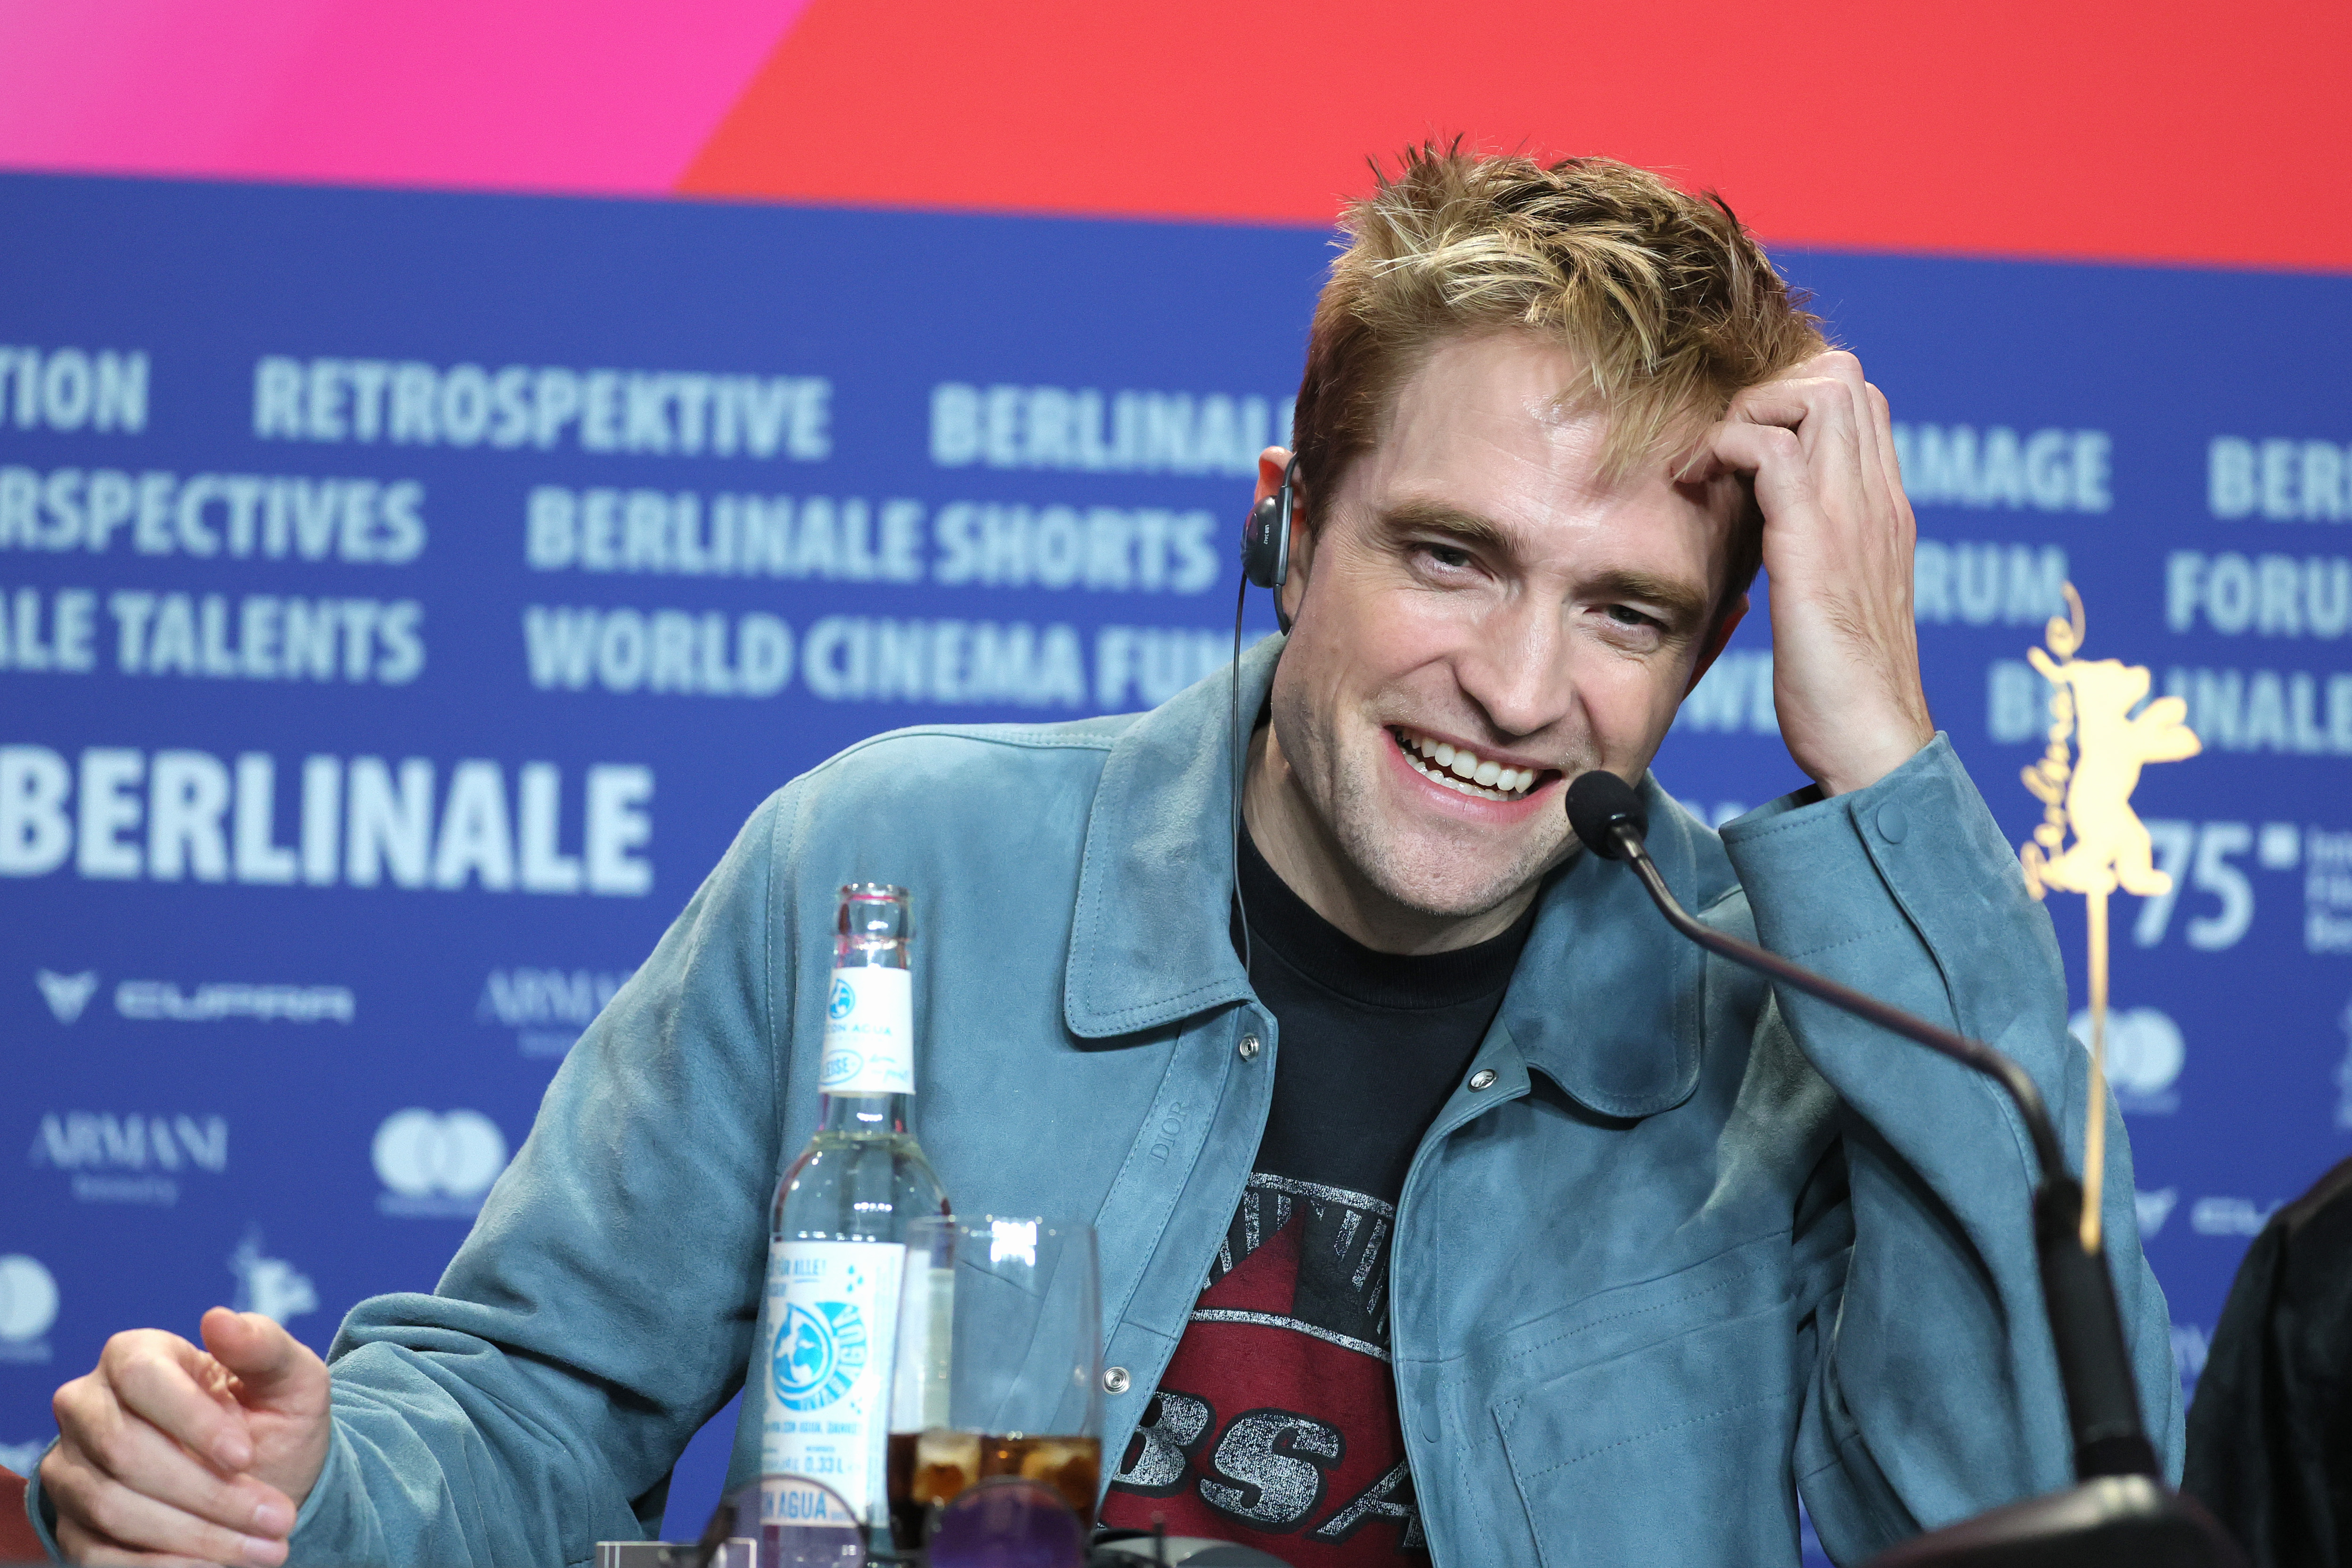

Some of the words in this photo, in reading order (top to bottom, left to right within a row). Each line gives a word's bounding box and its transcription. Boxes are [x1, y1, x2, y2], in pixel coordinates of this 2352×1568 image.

[253, 356, 831, 461] RETROSPEKTIVE
[2208, 436, 2352, 522] BER
[527, 486, 924, 583] BERLINALE
[935, 501, 1219, 595] SHORTS
[0, 588, 94, 672] LE
[109, 591, 425, 685] TALENTS
[524, 605, 795, 698] WORLD
[802, 616, 1086, 708] CINEMA
[0, 743, 654, 896] BERLINALE
[1149, 1102, 1191, 1166] DIOR
[778, 1490, 827, 1519] AGUA
[1112, 1390, 1427, 1548] BSA
